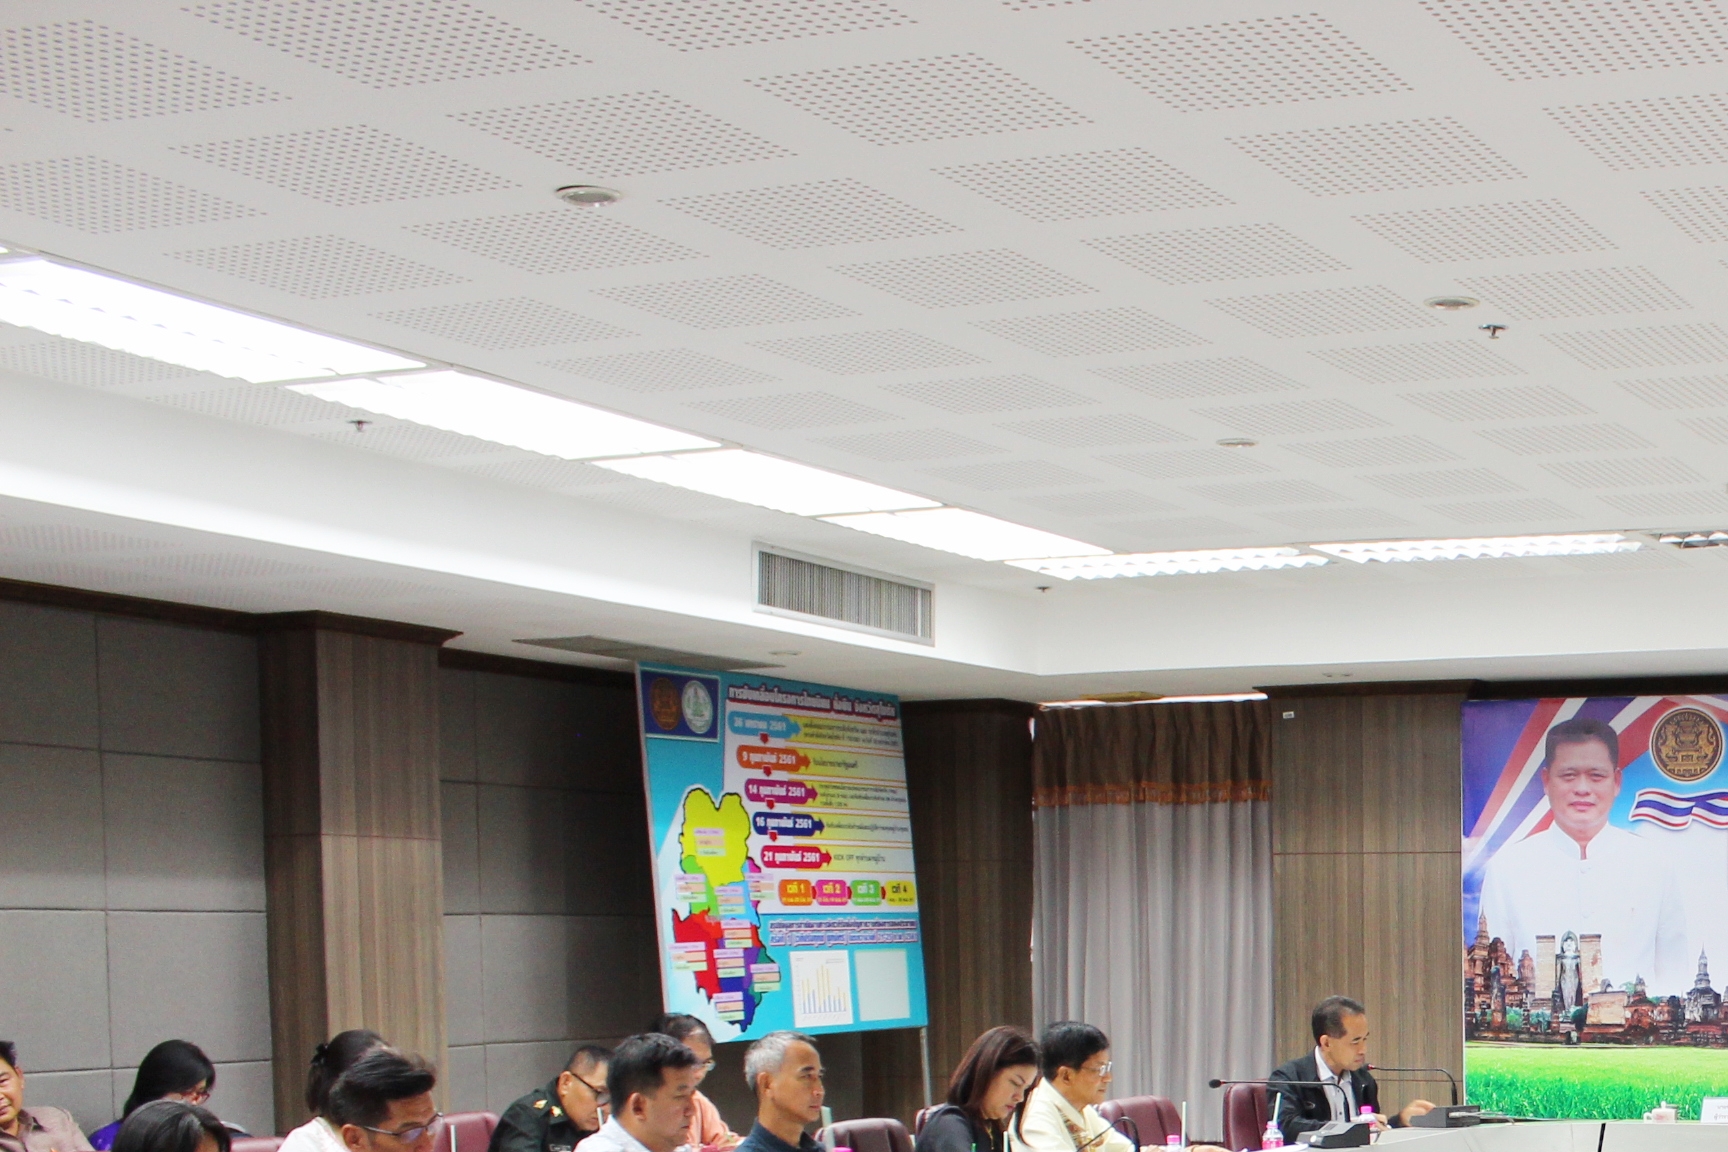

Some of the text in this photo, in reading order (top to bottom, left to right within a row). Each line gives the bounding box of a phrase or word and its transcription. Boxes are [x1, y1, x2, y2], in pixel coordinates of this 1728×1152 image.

[742, 751, 748, 761] 9
[779, 753, 796, 764] 2561
[748, 784, 758, 795] 14
[788, 786, 805, 797] 2561
[755, 816, 766, 827] 16
[795, 818, 812, 829] 2561
[763, 851, 773, 862] 21
[803, 852, 820, 863] 2561
